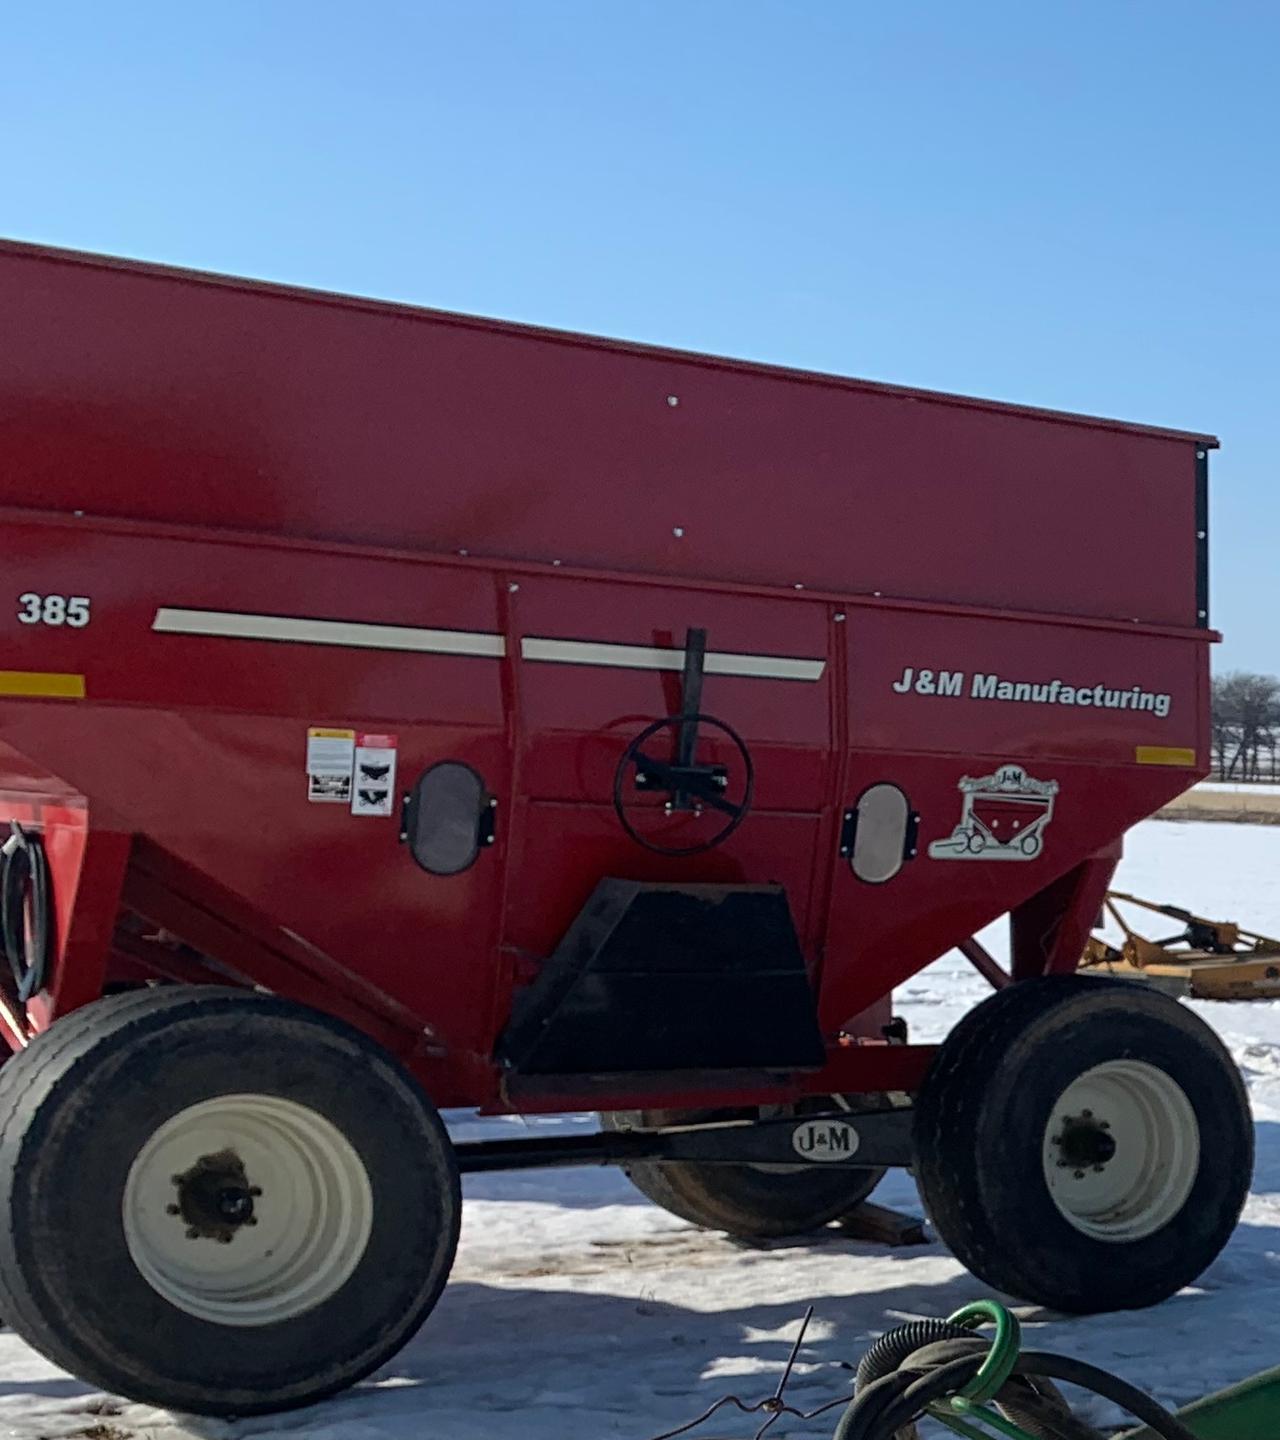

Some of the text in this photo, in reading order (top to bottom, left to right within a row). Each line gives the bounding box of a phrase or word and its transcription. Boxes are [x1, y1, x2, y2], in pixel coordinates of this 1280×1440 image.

[17, 592, 91, 628] 385
[893, 668, 1171, 717] J&M Manufacturing
[799, 1127, 850, 1152] J&M
